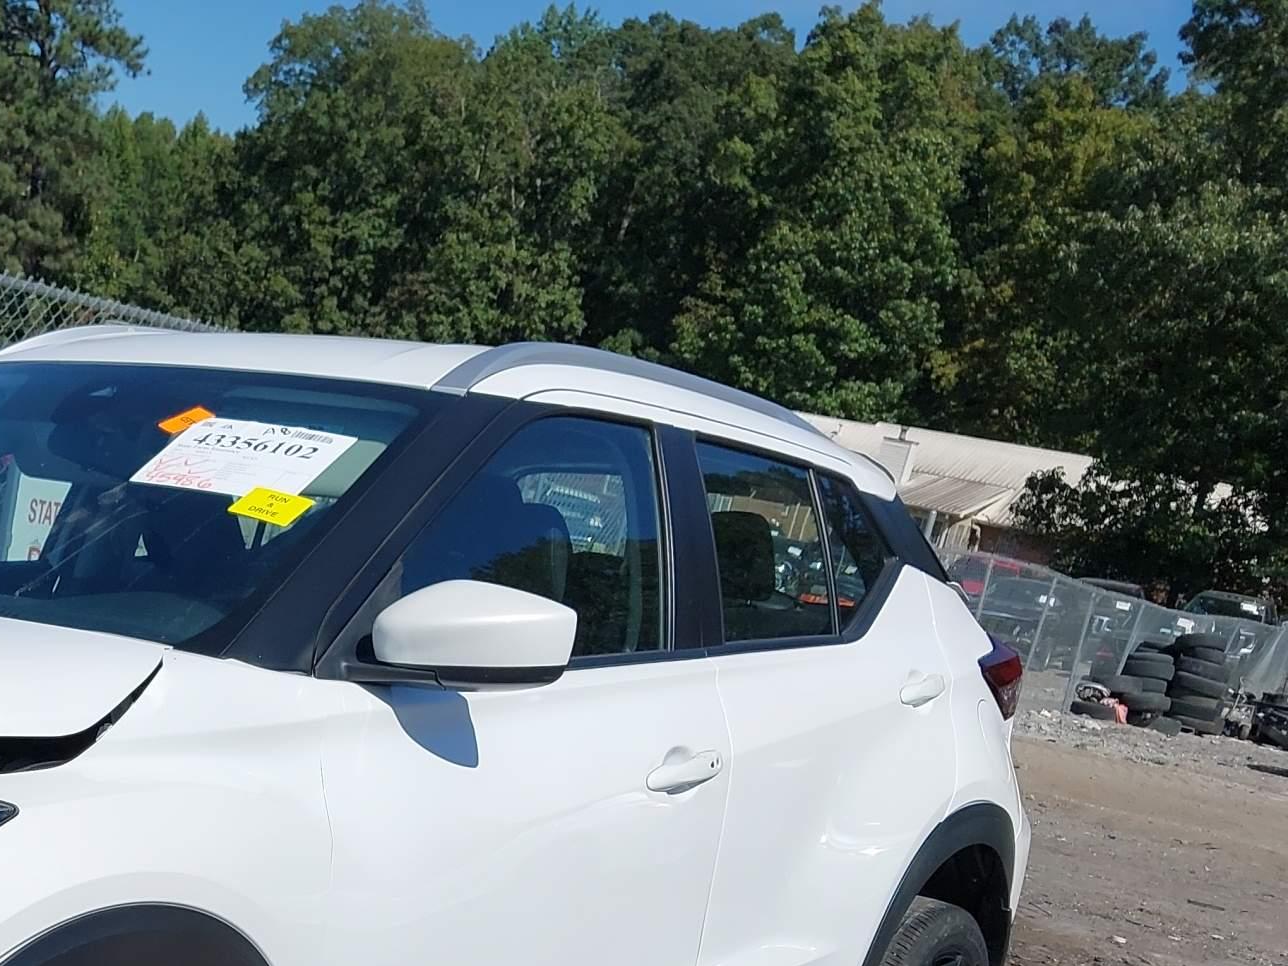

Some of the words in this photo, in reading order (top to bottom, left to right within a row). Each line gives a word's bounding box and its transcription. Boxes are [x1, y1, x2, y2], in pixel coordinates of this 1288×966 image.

[192, 431, 320, 460] 43356102
[267, 494, 291, 504] RUN
[247, 505, 280, 517] DRIVE
